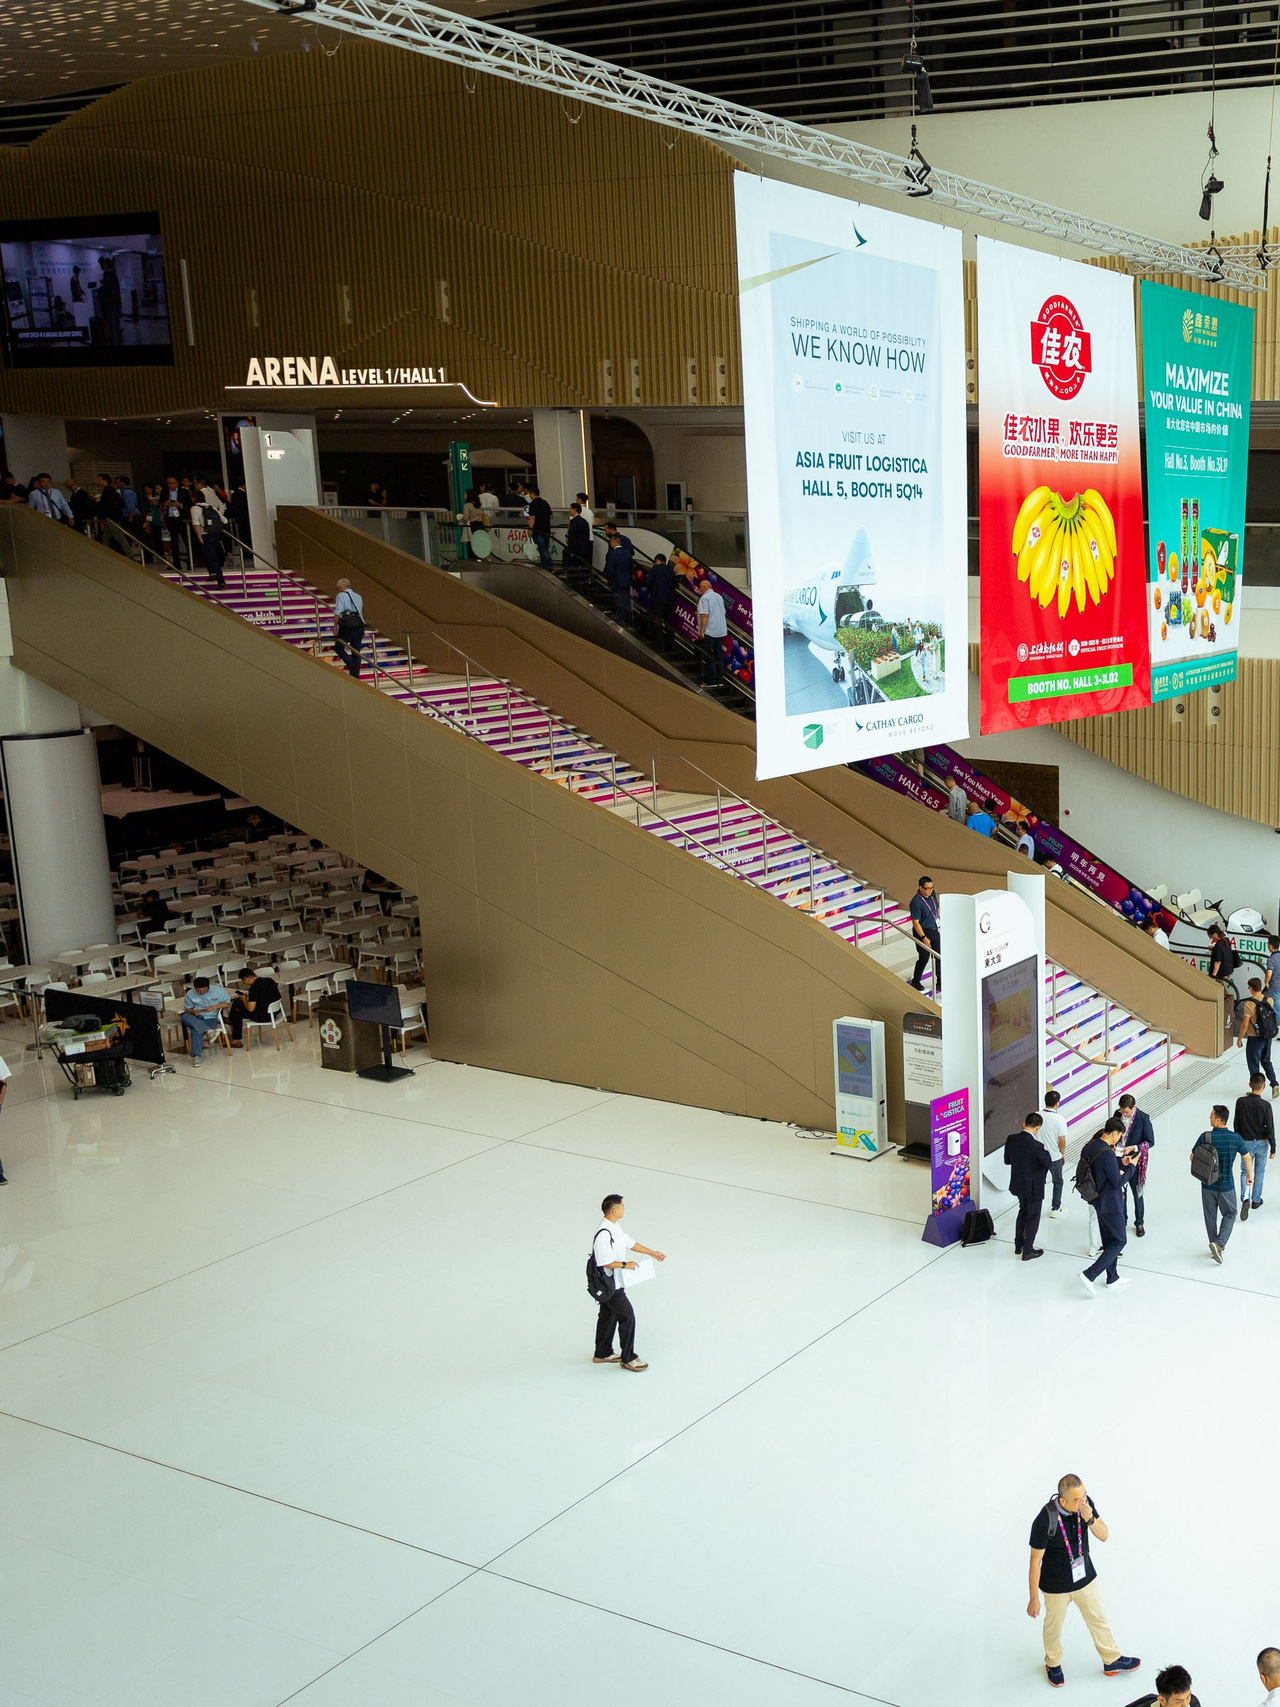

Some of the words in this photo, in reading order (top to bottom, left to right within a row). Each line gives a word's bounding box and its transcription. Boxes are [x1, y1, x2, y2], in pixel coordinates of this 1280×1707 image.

[1042, 301, 1079, 326] GOODFARMER
[790, 316, 830, 334] SHIPPING
[832, 323, 838, 335] A
[839, 325, 869, 340] WORLD
[870, 330, 881, 341] OF
[882, 331, 927, 348] POSSIBILITY
[791, 332, 822, 360] WE
[827, 338, 882, 368] KNOW
[887, 348, 926, 374] HOW
[1040, 326, 1083, 369] 佳农
[246, 356, 340, 387] ARENA
[341, 368, 384, 385] LEVEL
[438, 366, 445, 383] 1
[1165, 362, 1230, 396] MAXIMIZE
[1150, 390, 1174, 411] YOUR
[1175, 395, 1203, 416] VALUE
[1204, 401, 1215, 417] IN
[1216, 401, 1243, 420] CHINA
[1166, 417, 1229, 437] 最大化您在中国市场的价值
[841, 430, 862, 444] VISIT
[863, 432, 876, 445] US
[876, 434, 887, 446] AT
[795, 451, 825, 469] ASIA
[828, 453, 862, 471] FRUIT
[866, 455, 928, 474] LOGISTICA
[1004, 444, 1059, 461] GOODFARMER,
[1060, 449, 1079, 461] MORE
[1080, 449, 1099, 462] THAN
[1164, 452, 1175, 469] Hall
[1189, 454, 1206, 472] Booth
[802, 480, 833, 497] HALL
[836, 481, 848, 500] 5,
[851, 481, 893, 499] BOOTH
[896, 483, 923, 501] 5Q14
[508, 530, 528, 541] ASIA
[675, 606, 695, 626] HALL
[737, 604, 748, 615] See
[1027, 680, 1056, 695] BOOTH
[1057, 678, 1072, 692] NO.
[1073, 676, 1093, 690] HALL
[1094, 671, 1119, 687] 3-3L02
[866, 718, 897, 732] CATHAY
[897, 713, 924, 727] CARGO
[888, 730, 907, 738] MOVE
[909, 723, 935, 736] BEYOND
[882, 761, 898, 776] FRUIT
[934, 752, 950, 765] FRUIT
[898, 774, 919, 796] HALL
[953, 766, 964, 778] See
[964, 773, 976, 786] You
[975, 781, 990, 797] Next
[990, 792, 1004, 807] Year
[1048, 836, 1064, 850] FRUIT
[979, 912, 991, 934] G
[1239, 939, 1266, 952] FRUI
[935, 1106, 965, 1121] LOGISTICA
[948, 1098, 964, 1110] FRUIT
